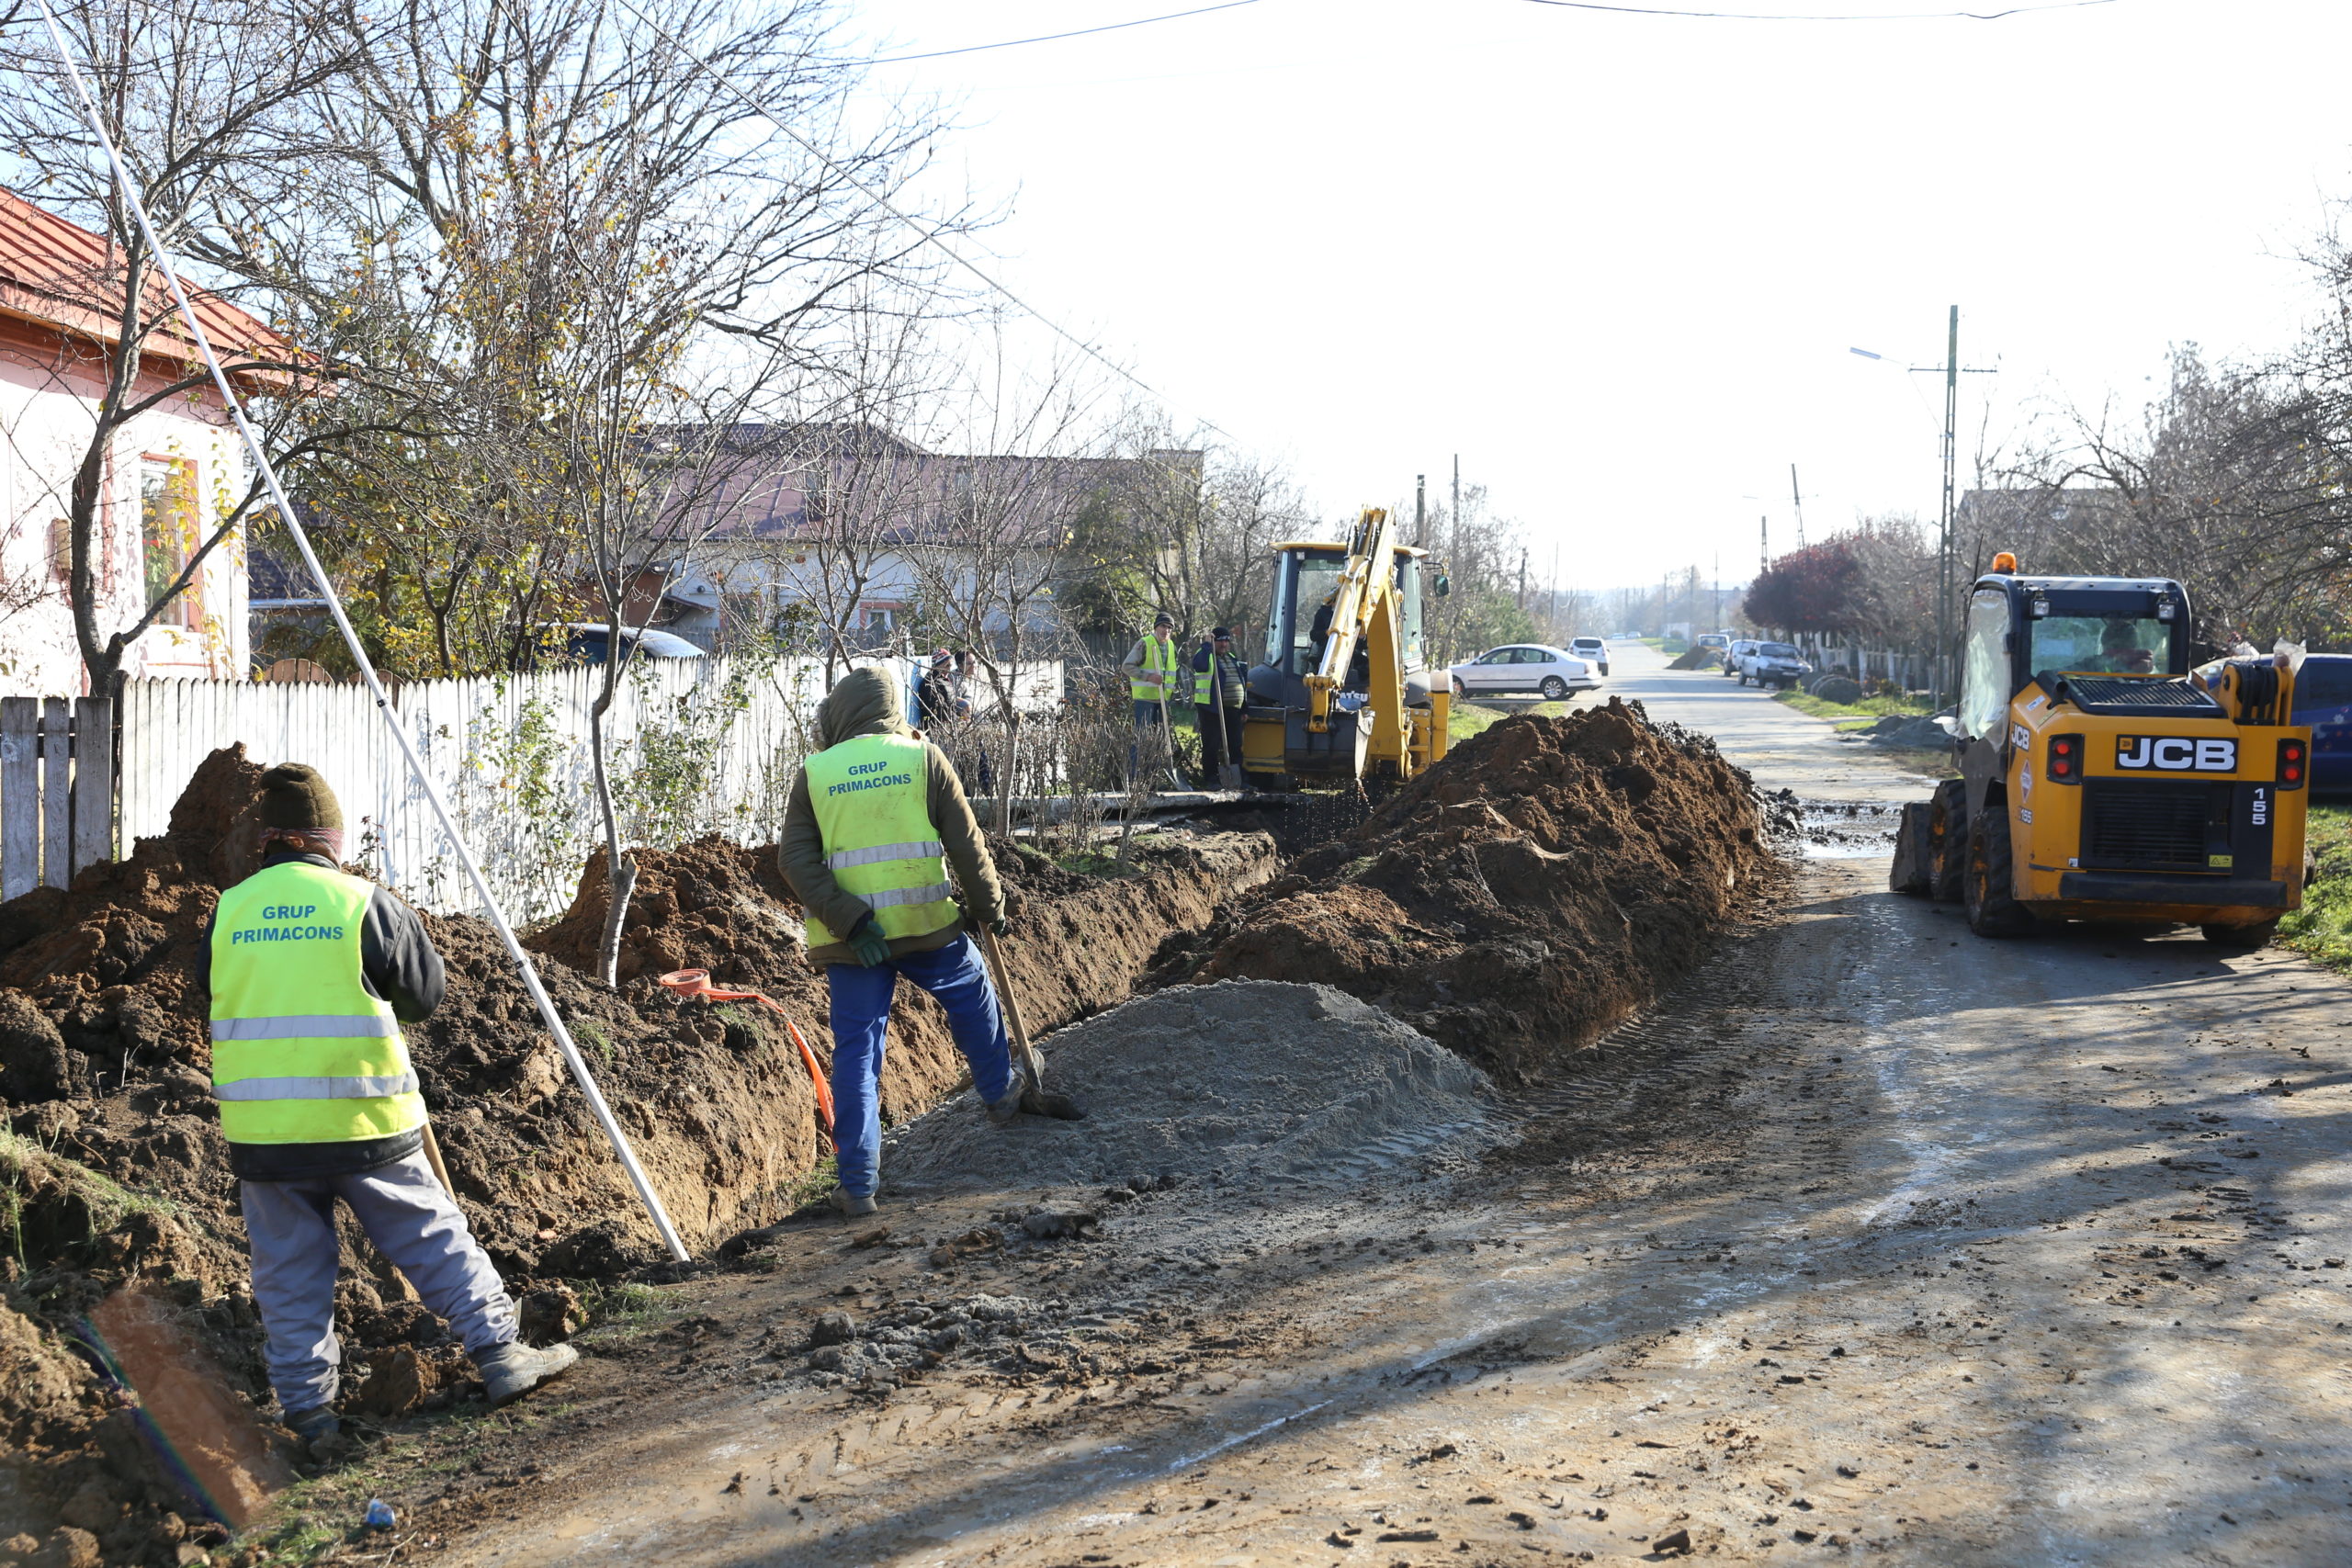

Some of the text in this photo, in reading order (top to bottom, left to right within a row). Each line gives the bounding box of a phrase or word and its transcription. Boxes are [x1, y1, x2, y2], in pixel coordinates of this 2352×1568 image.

[1340, 691, 1368, 702] ATSU
[2012, 724, 2030, 750] JCB
[2119, 738, 2235, 771] JCB
[848, 761, 888, 776] GRUP
[829, 773, 911, 796] PRIMACONS
[2252, 788, 2267, 825] 155
[262, 905, 316, 919] GRUP
[232, 926, 344, 944] PRIMACONS
